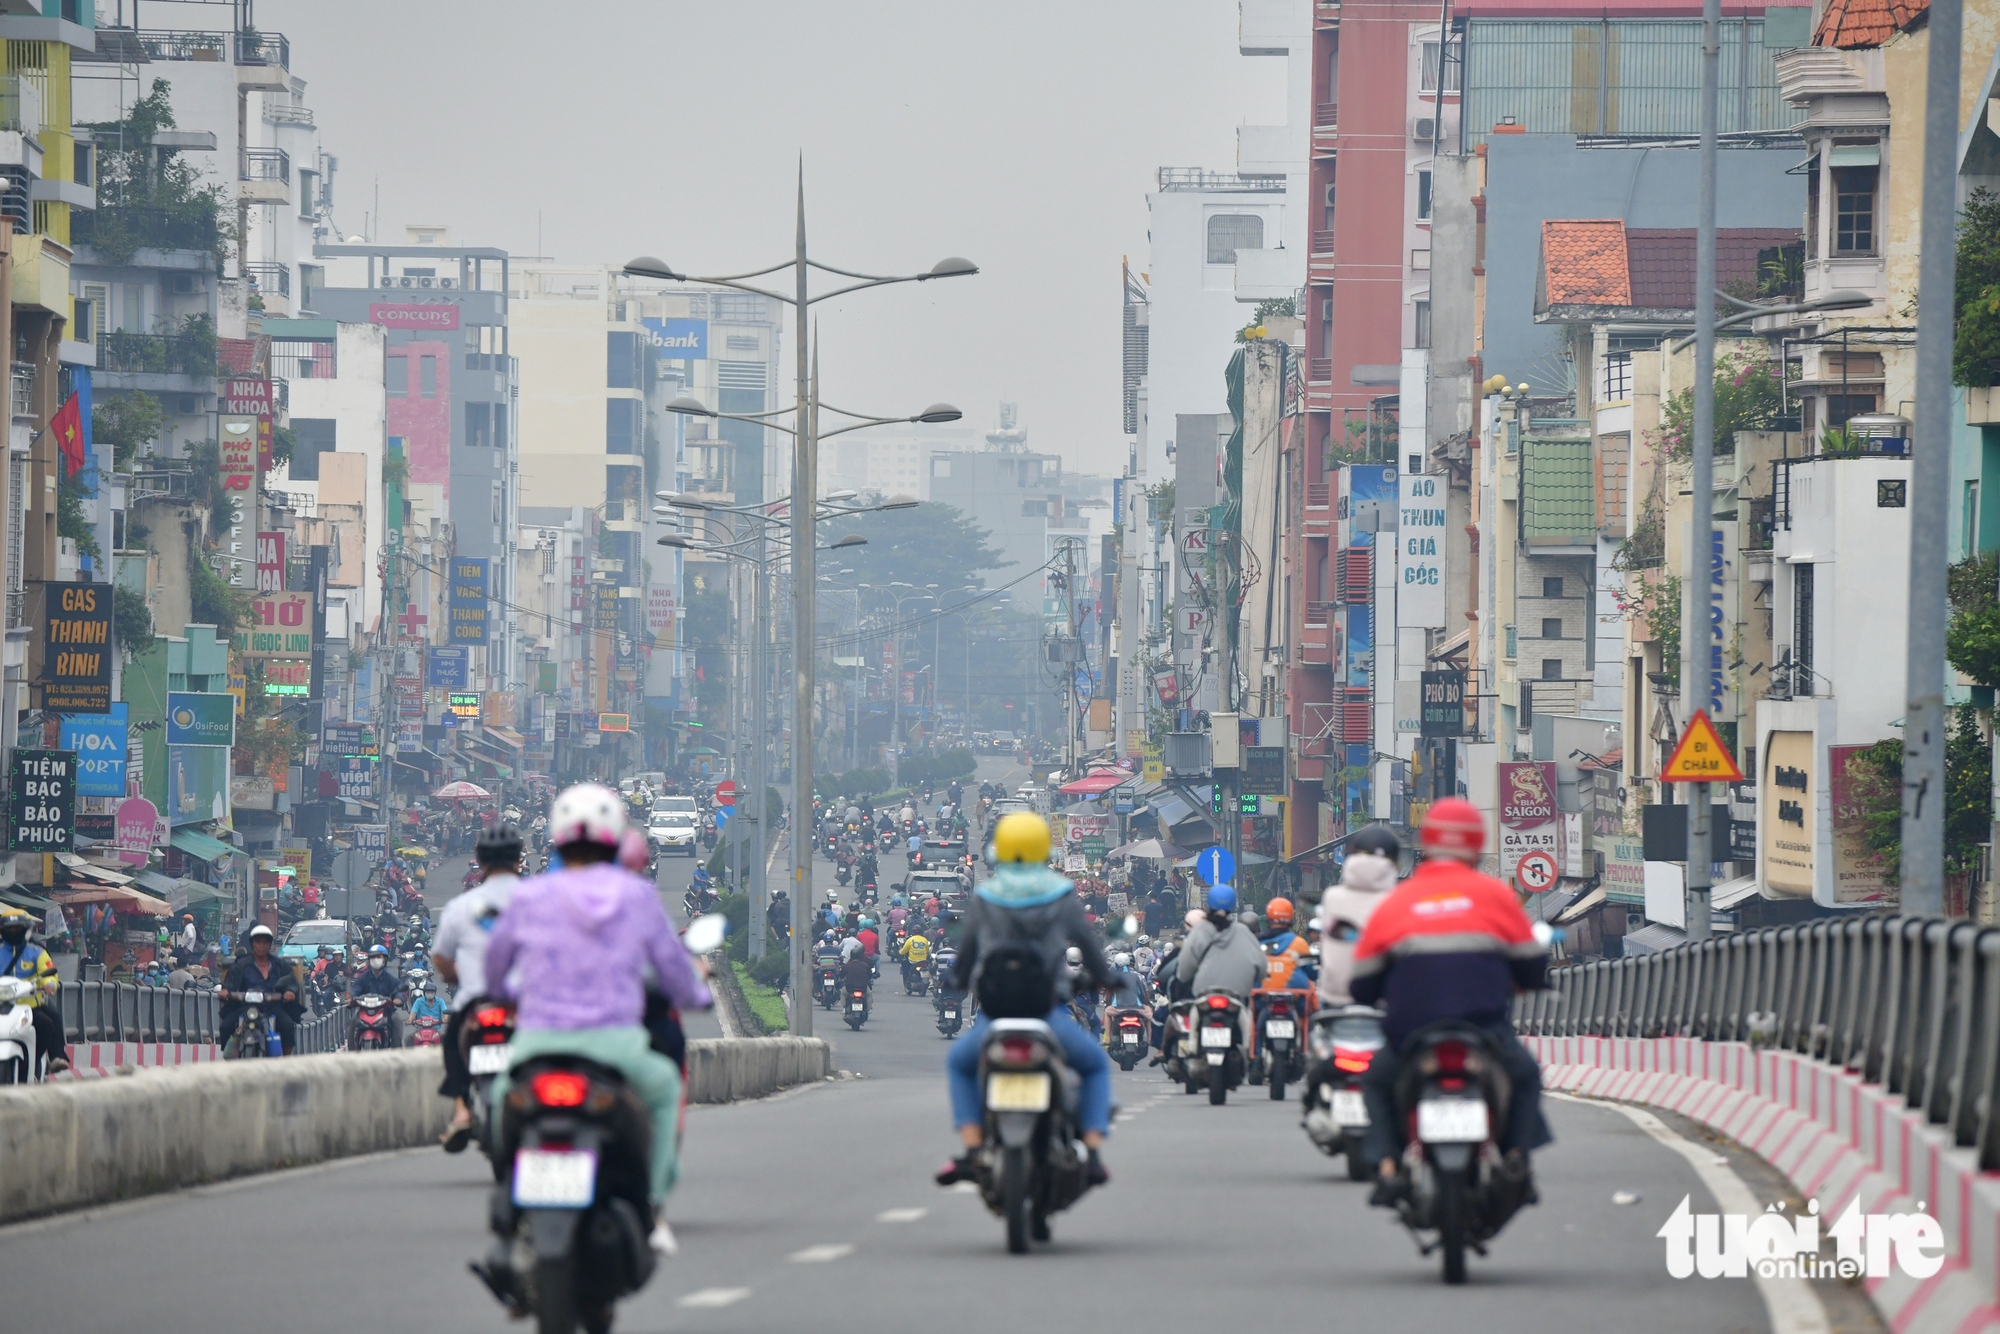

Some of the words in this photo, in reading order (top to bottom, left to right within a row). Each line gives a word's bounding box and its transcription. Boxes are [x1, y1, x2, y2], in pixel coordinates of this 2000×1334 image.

[233, 382, 265, 397] NHA
[227, 400, 270, 415] KHOA
[1412, 477, 1435, 497] ÁO
[1401, 508, 1445, 526] THUN
[256, 538, 278, 564] HA
[1408, 536, 1436, 556] GIÁ
[457, 563, 481, 581] TIỆM
[1404, 562, 1438, 585] GỐC
[456, 583, 482, 598] VÀNG
[599, 587, 618, 600] VÀNG
[652, 589, 672, 597] NHA
[62, 588, 96, 613] GAS
[648, 599, 674, 609] KHOA
[252, 595, 306, 627] HỞ
[452, 606, 485, 621] THÀNH
[50, 619, 108, 644] THANH
[455, 623, 482, 638] CÔNG
[650, 619, 672, 628] NAM
[251, 632, 282, 655] NGỌC
[285, 634, 310, 652] LINH
[56, 647, 101, 677] BÌNH
[1425, 675, 1445, 703] PHỞ
[1446, 678, 1460, 703] BÒ
[1445, 708, 1460, 722] LAN
[195, 721, 229, 731] OsiFood
[71, 732, 117, 750] HOA
[1694, 741, 1708, 753] ĐI
[22, 757, 66, 780] TIỆM
[25, 781, 62, 800] BẠC
[24, 801, 61, 822] BẢO
[1505, 806, 1551, 817] SAIGON
[18, 823, 66, 843] PHÚC
[120, 826, 151, 841] Milk
[1505, 832, 1522, 845] GÀ
[1525, 835, 1540, 845] TA
[1542, 835, 1554, 845] 51
[121, 839, 147, 851] tea
[1606, 863, 1644, 884] PHOTOCO
[1839, 871, 1856, 880] BÚN
[911, 939, 925, 950] be
